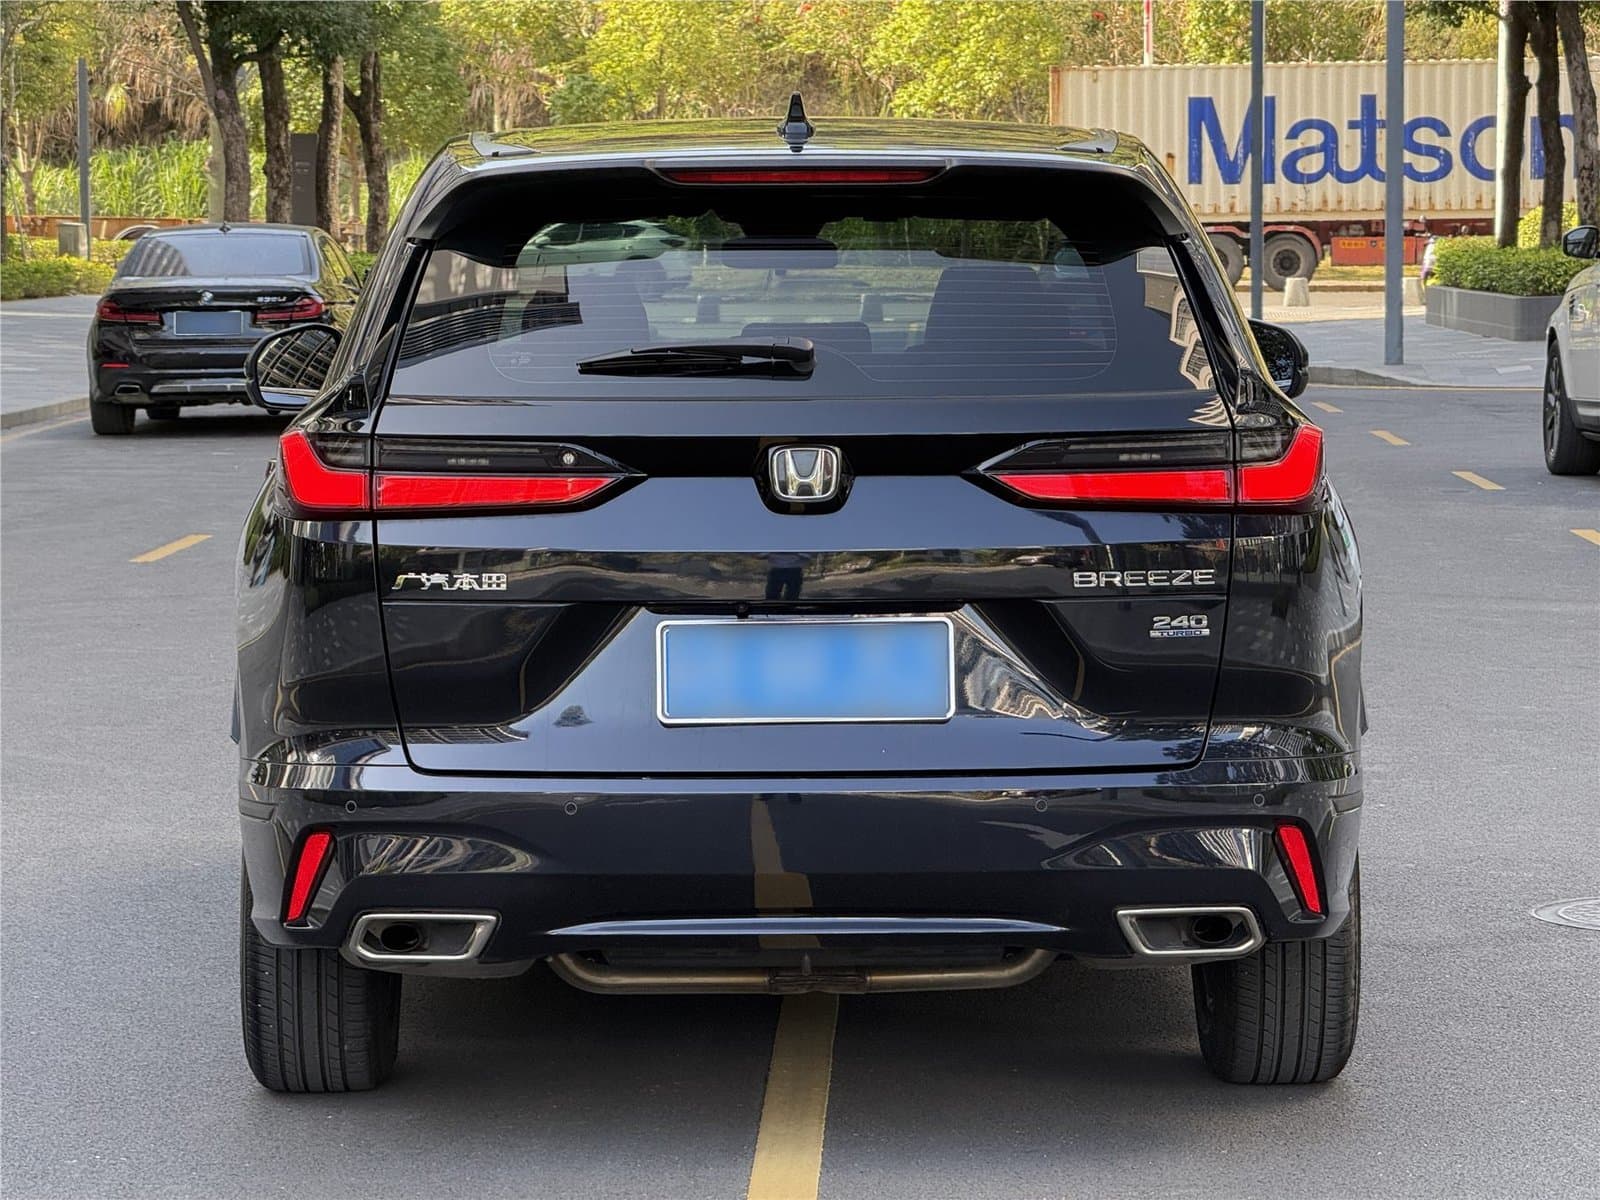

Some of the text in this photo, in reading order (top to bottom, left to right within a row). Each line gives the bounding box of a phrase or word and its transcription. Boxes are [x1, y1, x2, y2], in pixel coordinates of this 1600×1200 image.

[392, 573, 507, 590] 广汽本田
[1073, 569, 1216, 587] BREEZE
[1153, 615, 1208, 629] 240
[1157, 629, 1203, 637] TURBO
